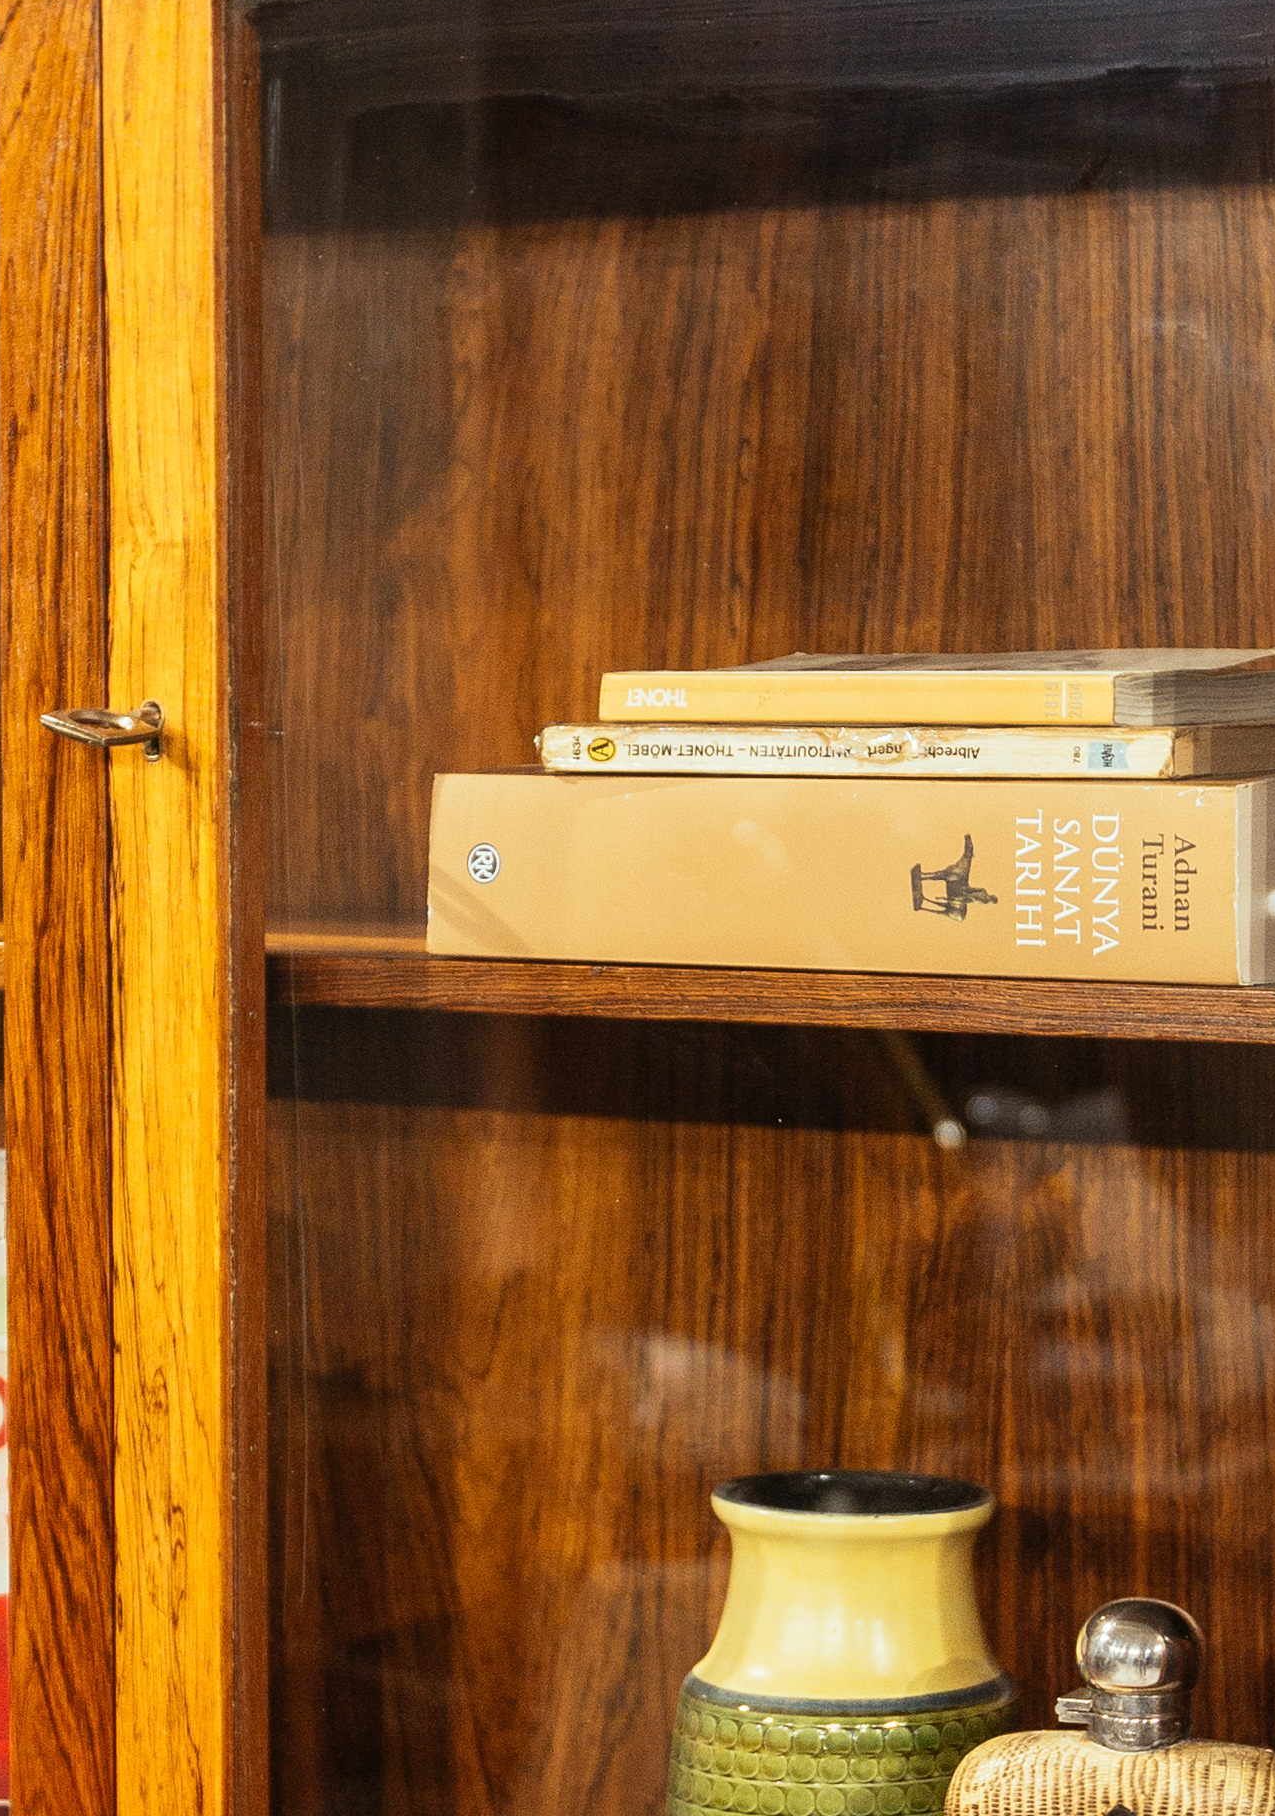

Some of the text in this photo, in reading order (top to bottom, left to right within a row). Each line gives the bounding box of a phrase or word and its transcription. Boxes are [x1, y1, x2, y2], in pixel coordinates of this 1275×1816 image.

[625, 687, 688, 708] THONET
[1015, 808, 1048, 948] TARİHİ
[1053, 817, 1082, 945] SANAT
[1091, 811, 1125, 956] DÜNYA
[1141, 833, 1165, 932] Turani
[1174, 833, 1198, 933] Adnan
